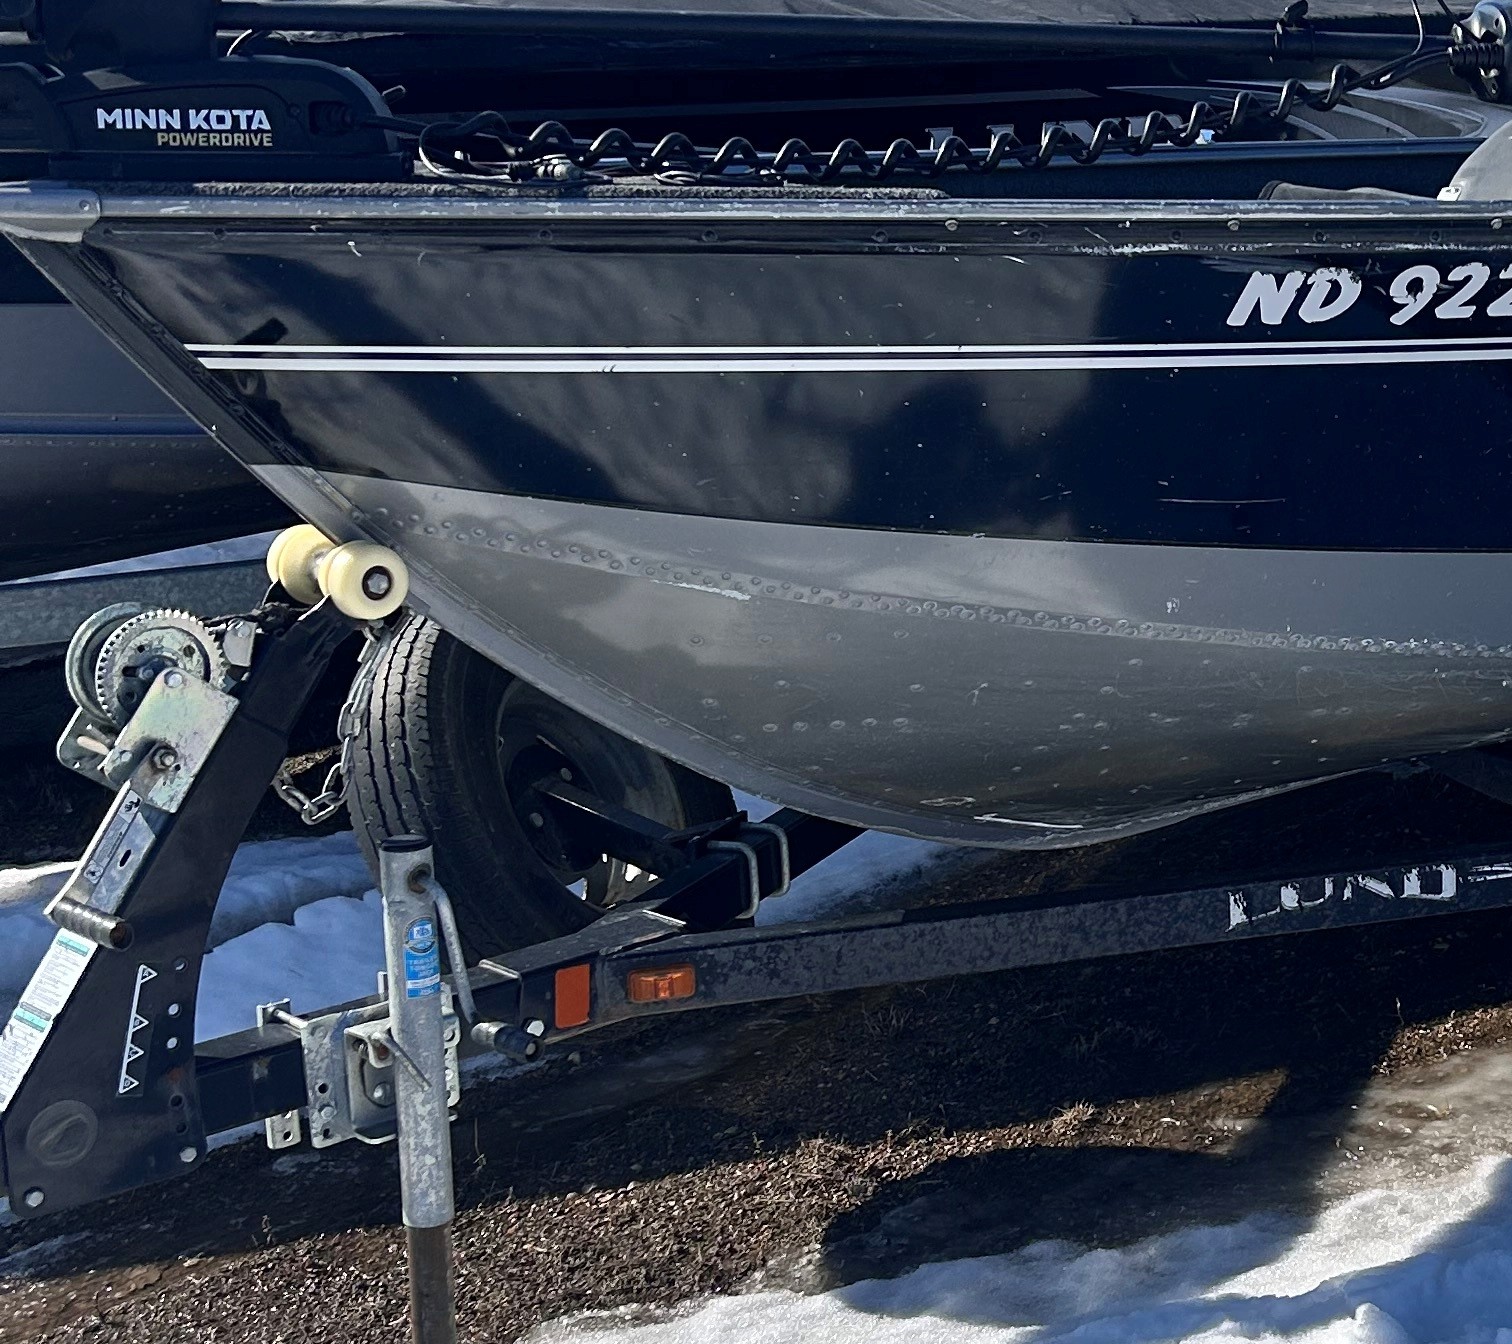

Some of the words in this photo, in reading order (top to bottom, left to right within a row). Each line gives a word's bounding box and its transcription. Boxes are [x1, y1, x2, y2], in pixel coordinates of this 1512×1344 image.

[96, 108, 181, 130] MINN
[188, 109, 272, 131] KOTA
[157, 132, 273, 147] POWERDRIVE
[1226, 267, 1362, 326] ND
[1225, 863, 1457, 932] LUND
